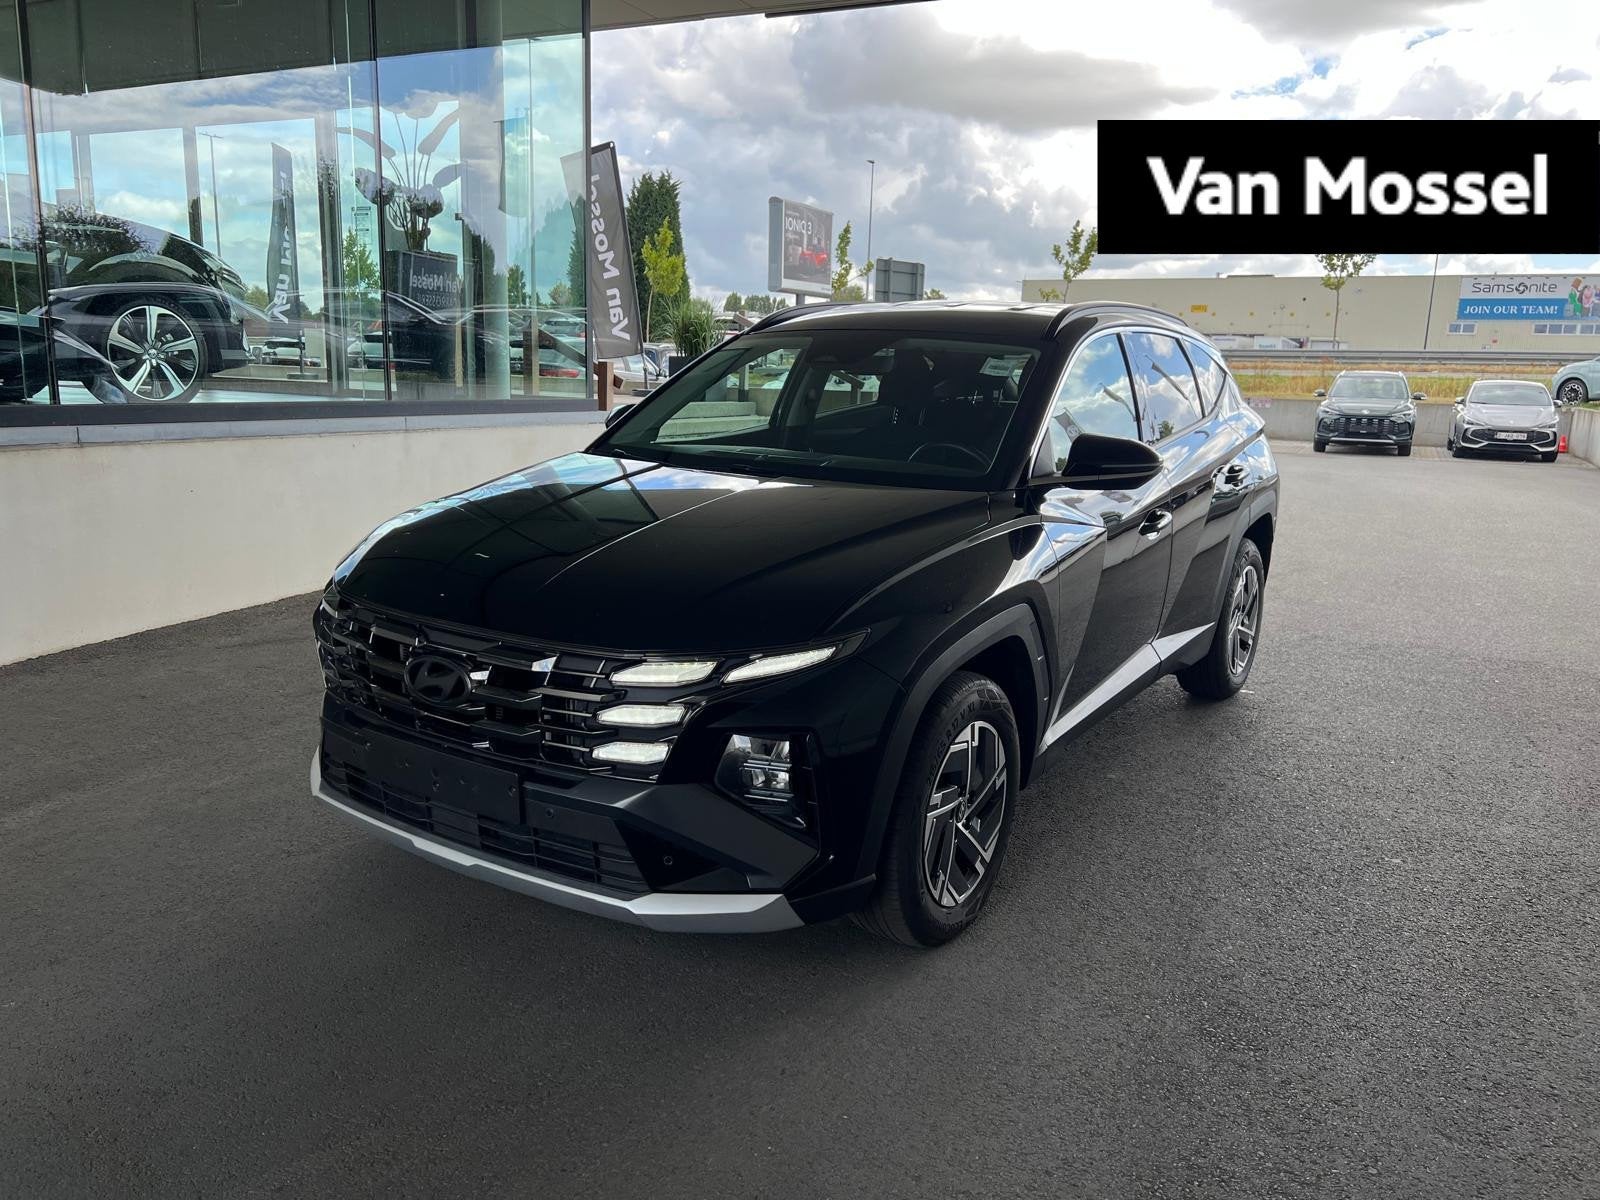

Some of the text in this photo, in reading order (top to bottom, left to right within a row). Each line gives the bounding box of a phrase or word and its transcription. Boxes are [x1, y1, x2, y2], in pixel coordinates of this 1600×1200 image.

[807, 221, 812, 235] 3
[1471, 281, 1558, 295] Samsonite
[1463, 305, 1558, 315] JOIN OUR TEAM!
